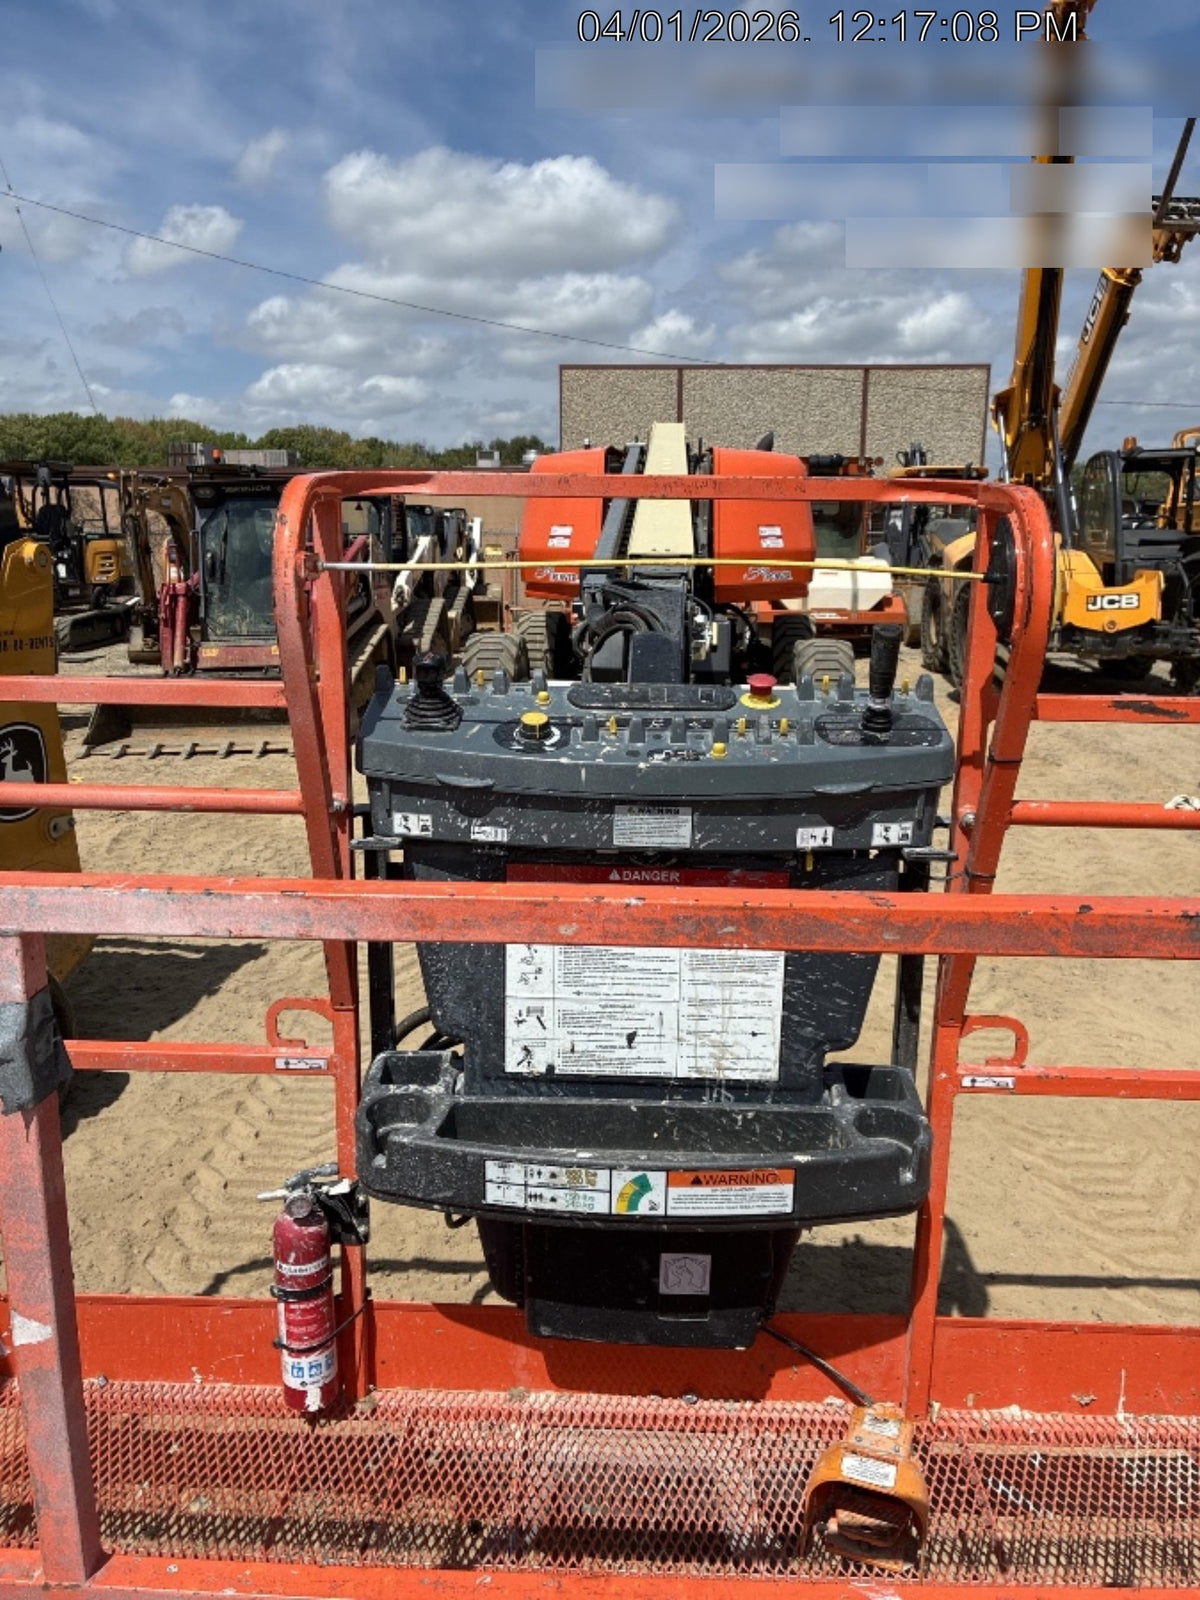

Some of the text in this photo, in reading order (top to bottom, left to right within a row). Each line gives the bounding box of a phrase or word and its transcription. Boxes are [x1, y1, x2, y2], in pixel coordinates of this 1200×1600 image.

[1087, 594, 1139, 611] JCB
[622, 870, 680, 882] DANGER
[704, 1172, 779, 1186] WARNING
